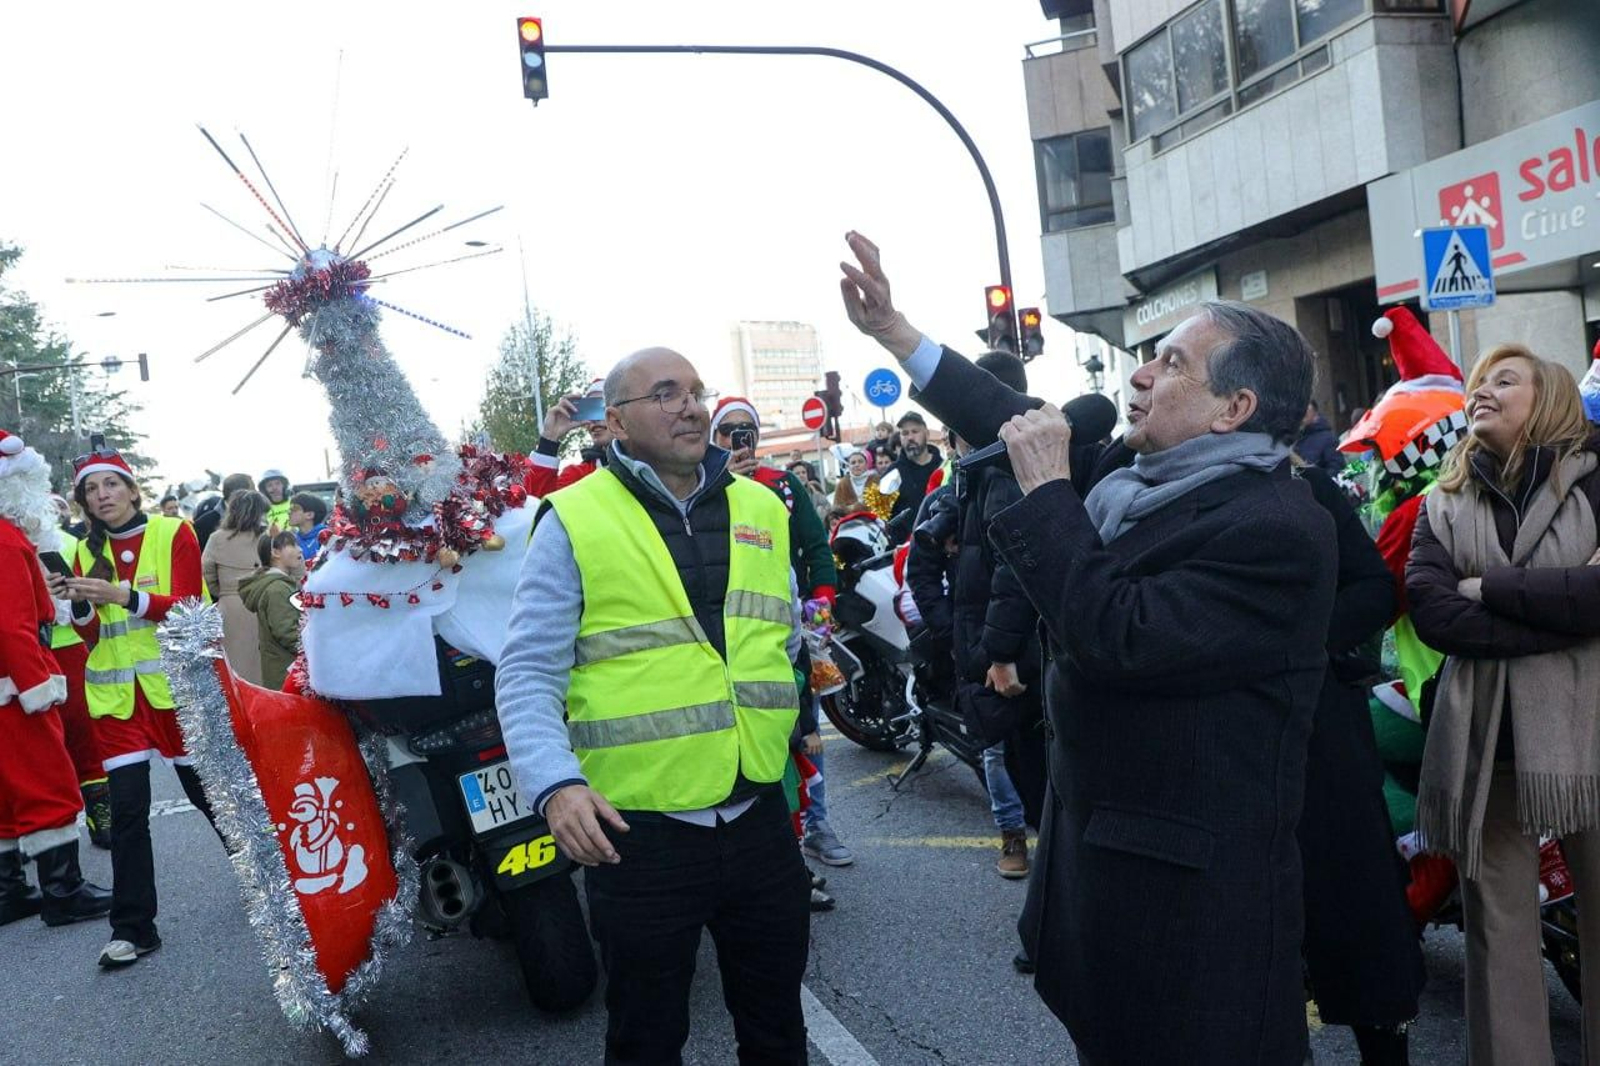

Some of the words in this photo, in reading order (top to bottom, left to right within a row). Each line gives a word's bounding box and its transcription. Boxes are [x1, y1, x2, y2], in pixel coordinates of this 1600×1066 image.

[1518, 127, 1600, 202] sal
[1136, 281, 1198, 326] COLCHONES
[483, 767, 512, 795] 40
[488, 792, 532, 824] HY
[497, 834, 556, 876] 46
